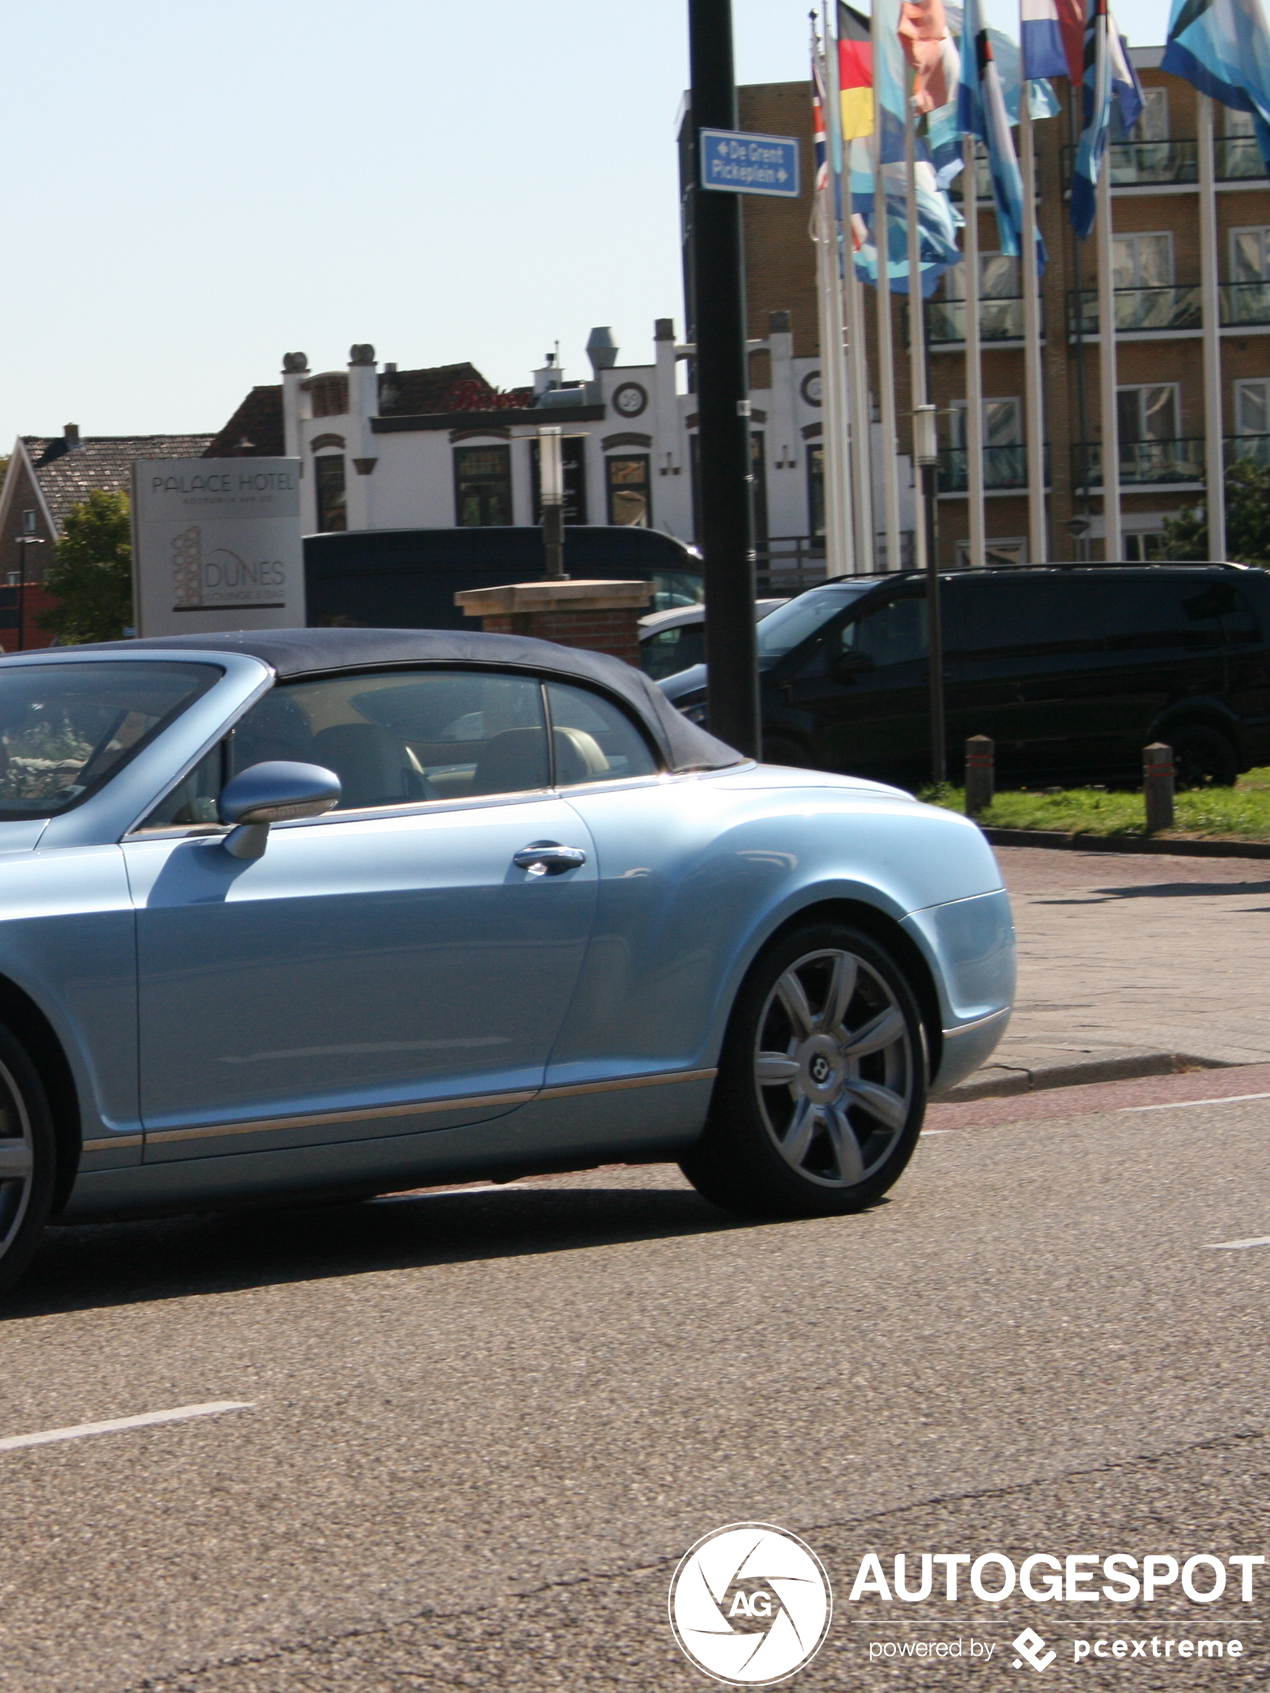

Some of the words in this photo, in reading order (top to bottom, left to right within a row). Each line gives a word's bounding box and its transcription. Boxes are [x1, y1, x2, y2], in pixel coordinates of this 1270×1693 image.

[730, 141, 747, 160] De
[748, 143, 784, 163] Grent
[152, 474, 232, 494] PALACE
[238, 472, 295, 491] HOTEL
[204, 561, 286, 588] DUNES
